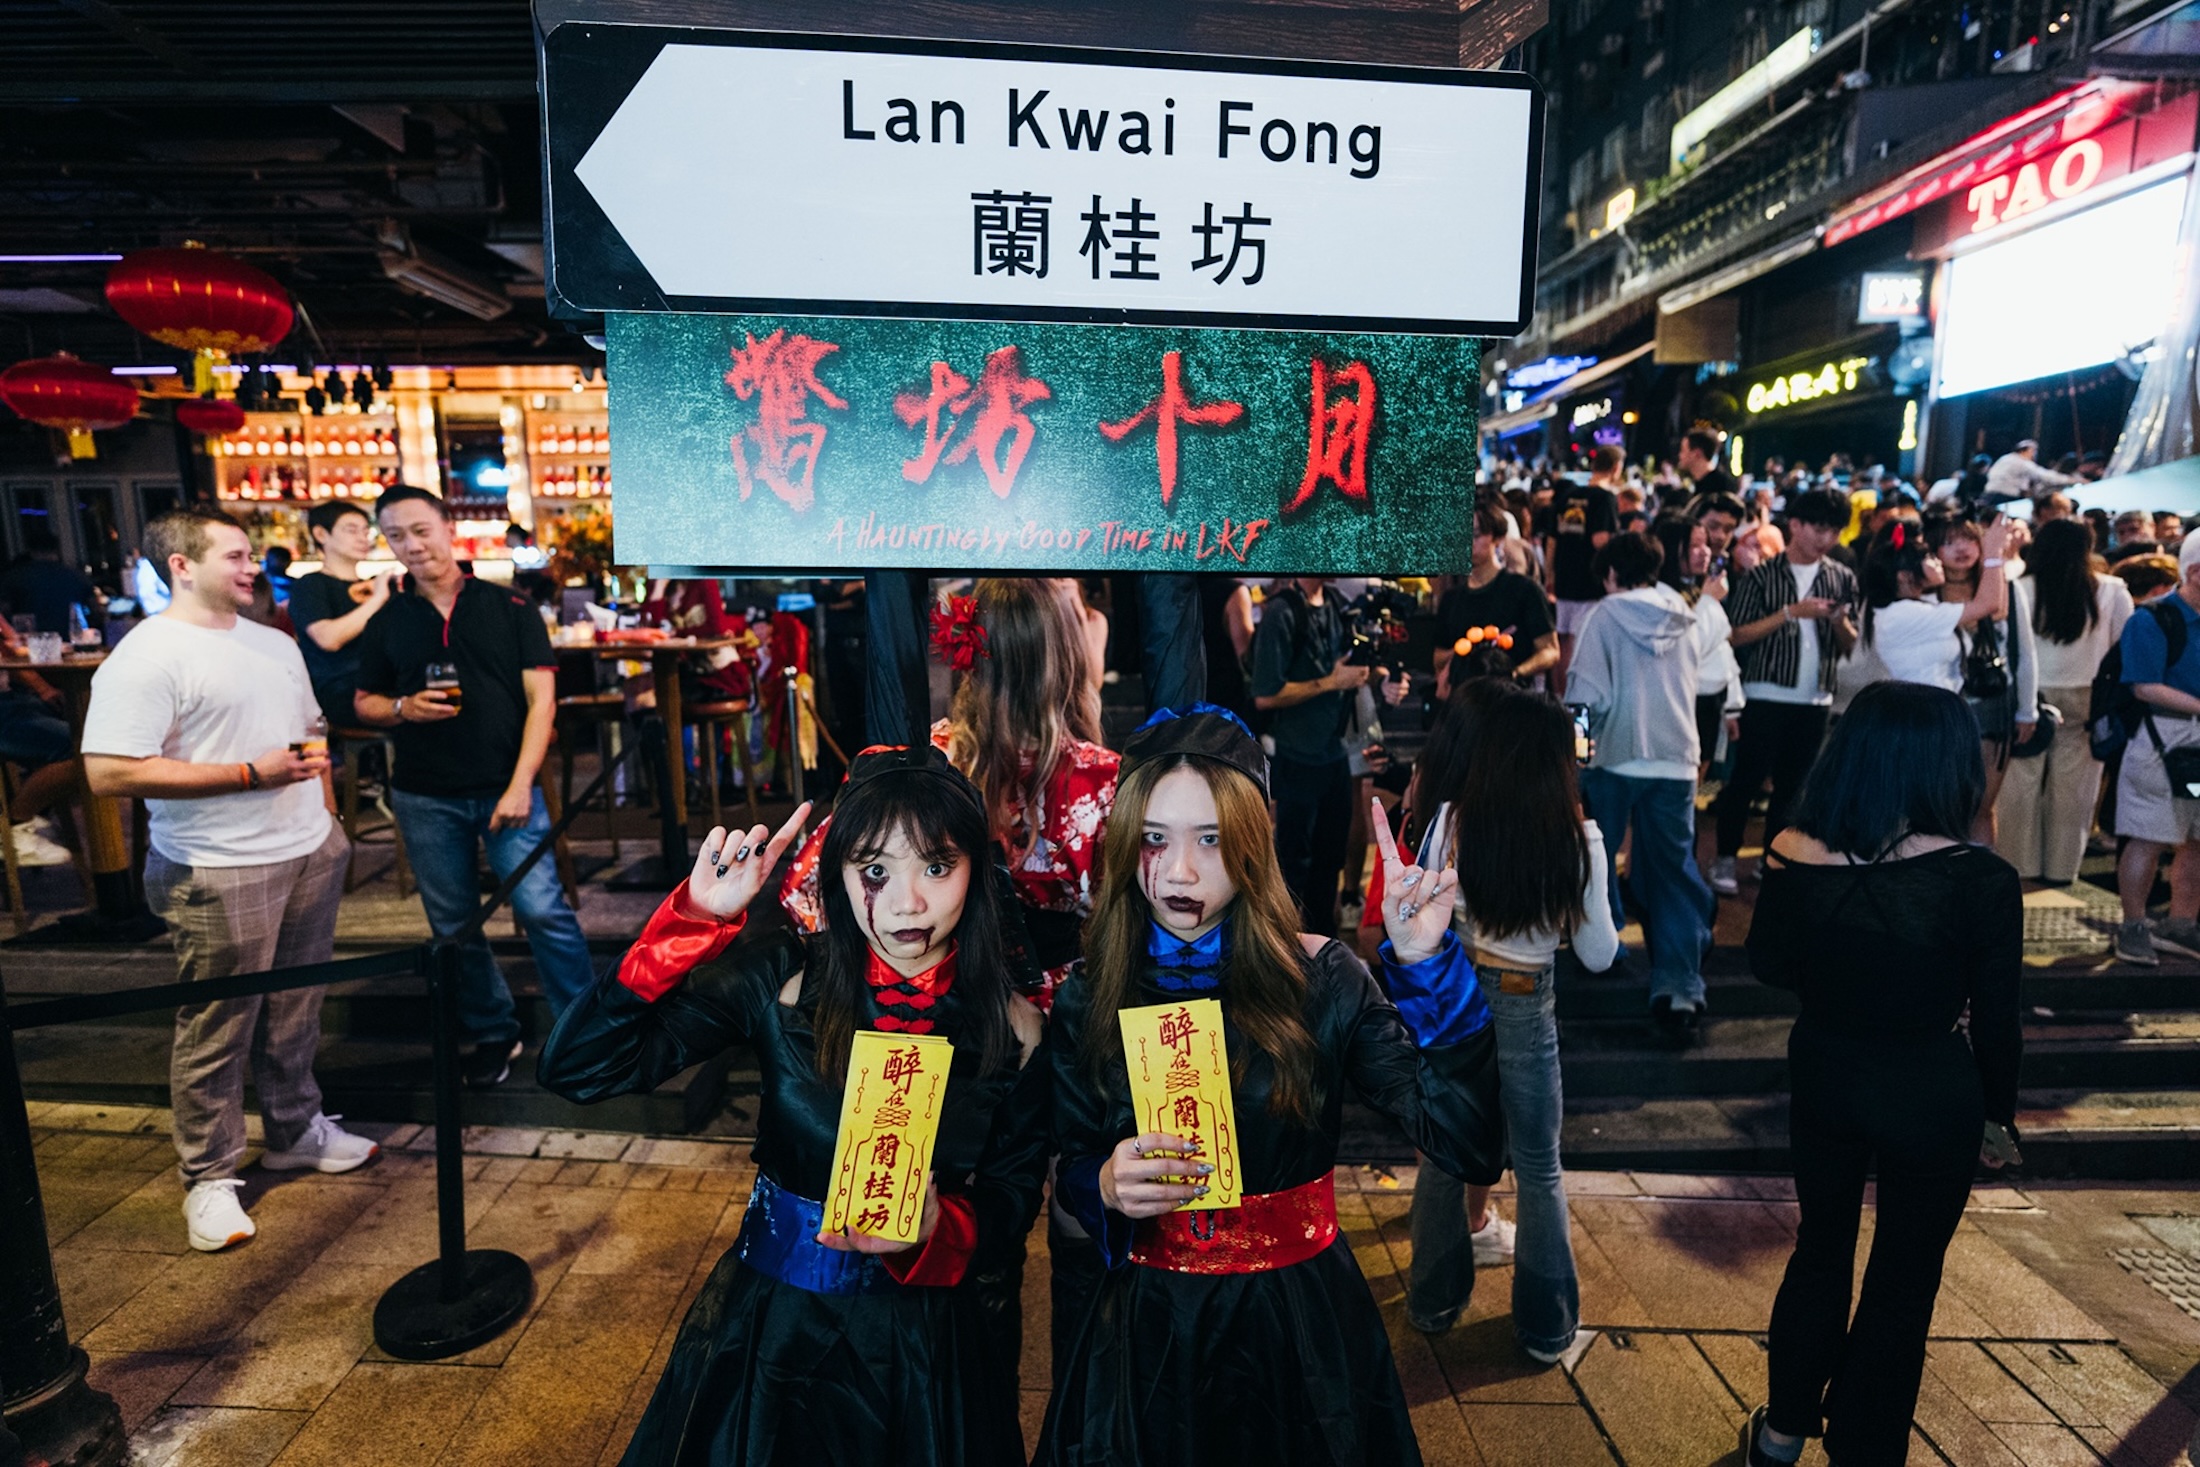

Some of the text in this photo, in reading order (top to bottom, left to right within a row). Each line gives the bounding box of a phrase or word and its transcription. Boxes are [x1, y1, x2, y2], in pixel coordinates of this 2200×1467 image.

[843, 79, 1381, 180] Lan Kwai Fong
[1967, 139, 2103, 233] TAO
[970, 189, 1272, 286] 蘭桂坊
[826, 517, 848, 554] A
[1194, 517, 1270, 562] LKF
